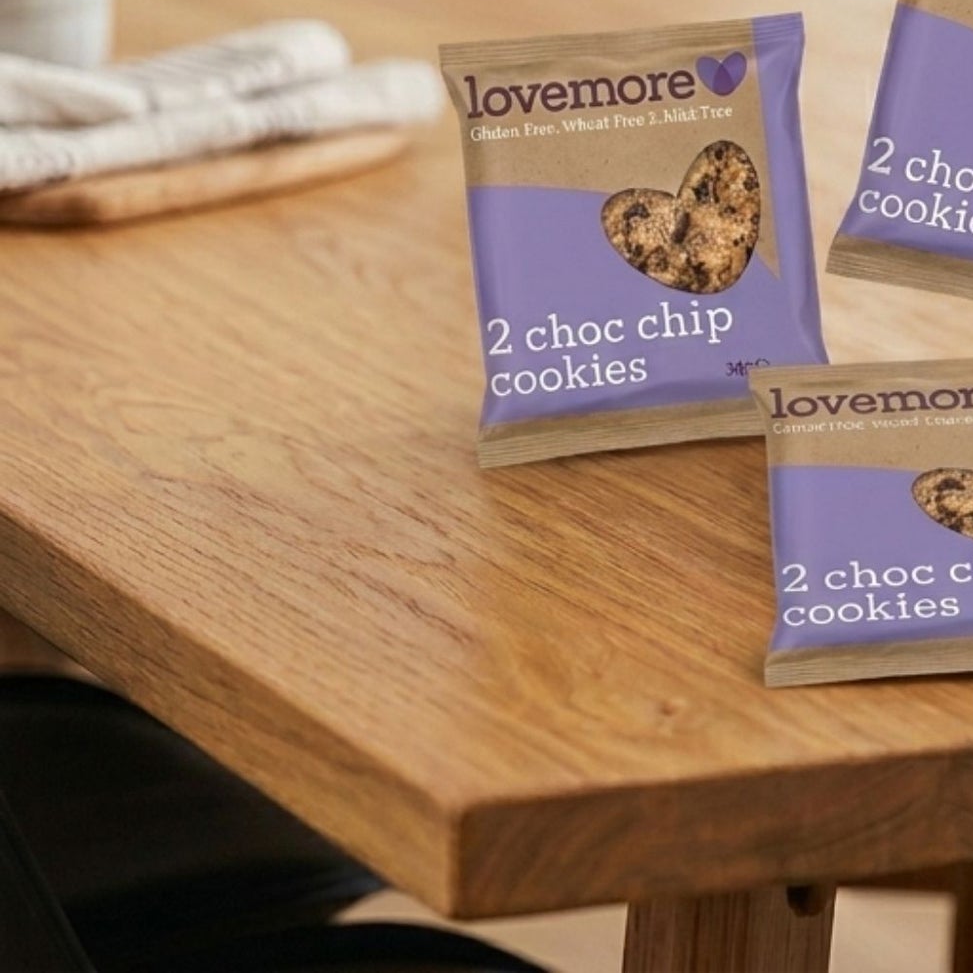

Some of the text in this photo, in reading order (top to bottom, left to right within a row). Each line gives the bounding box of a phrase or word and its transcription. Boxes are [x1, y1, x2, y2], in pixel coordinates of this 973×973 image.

[463, 69, 696, 119] lovemore
[867, 136, 895, 175] 2
[487, 300, 734, 355] 2 choc chip
[491, 354, 648, 396] cookies
[782, 564, 808, 592] 2
[824, 561, 935, 590] choc
[783, 592, 960, 626] cookies
